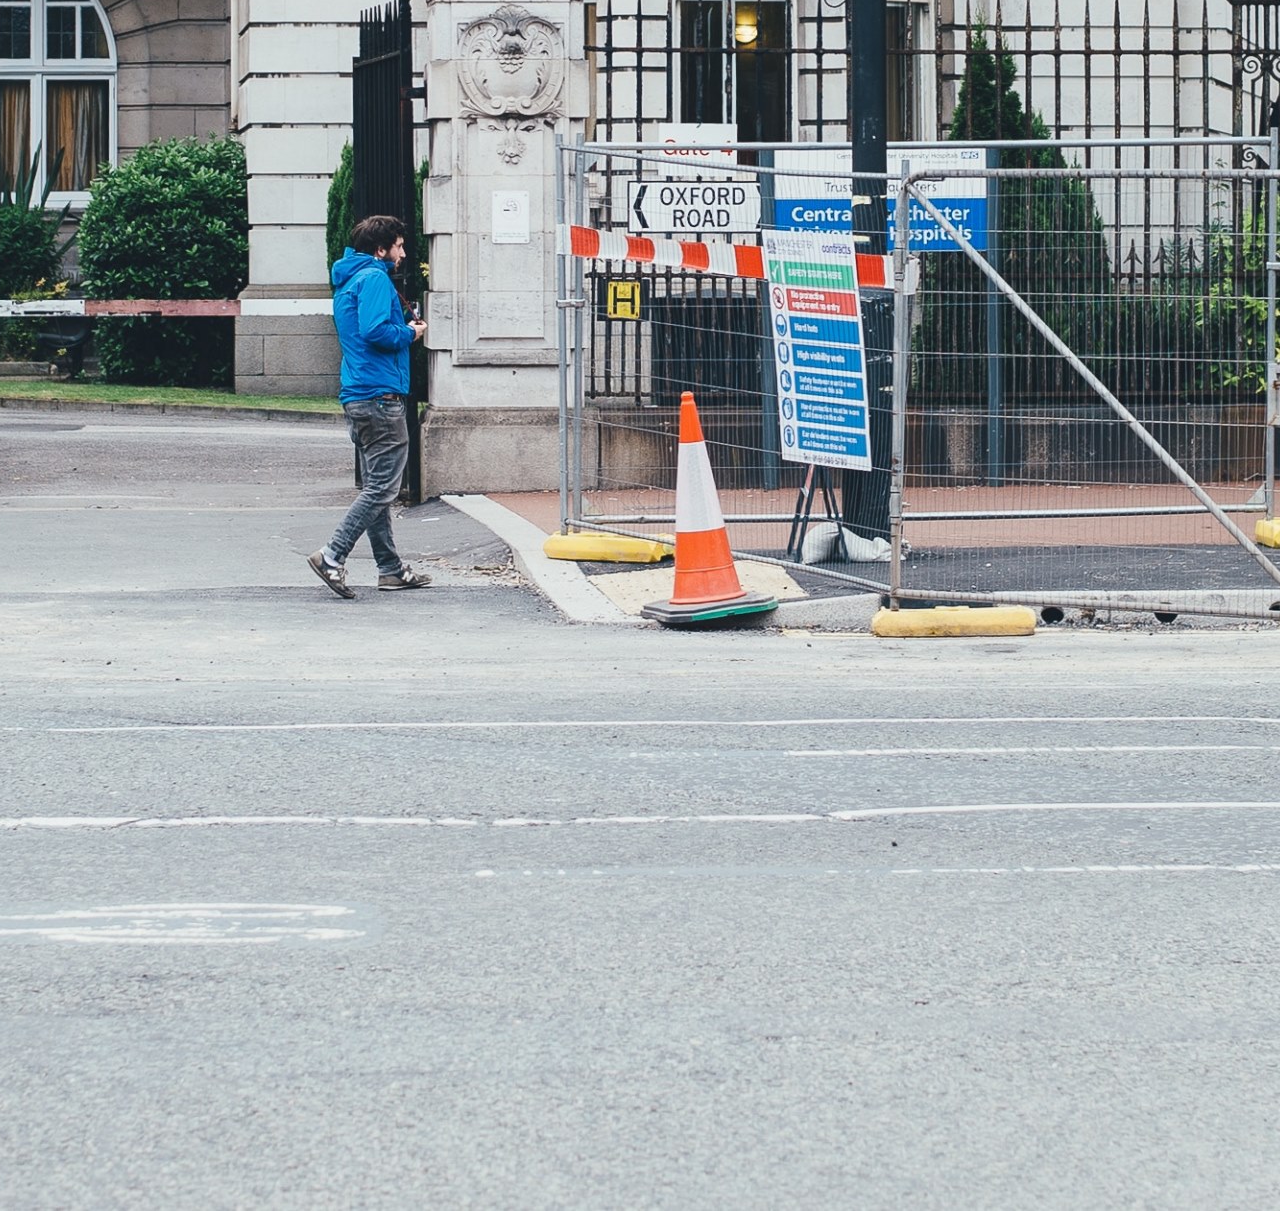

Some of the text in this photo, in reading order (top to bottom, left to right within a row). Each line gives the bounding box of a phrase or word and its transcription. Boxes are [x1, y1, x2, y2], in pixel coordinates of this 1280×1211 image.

[931, 152, 958, 161] Hospitals
[961, 151, 979, 159] NHS
[660, 187, 746, 206] OXFORD
[673, 209, 730, 228] ROAD
[791, 206, 852, 222] Centra
[613, 286, 635, 315] H
